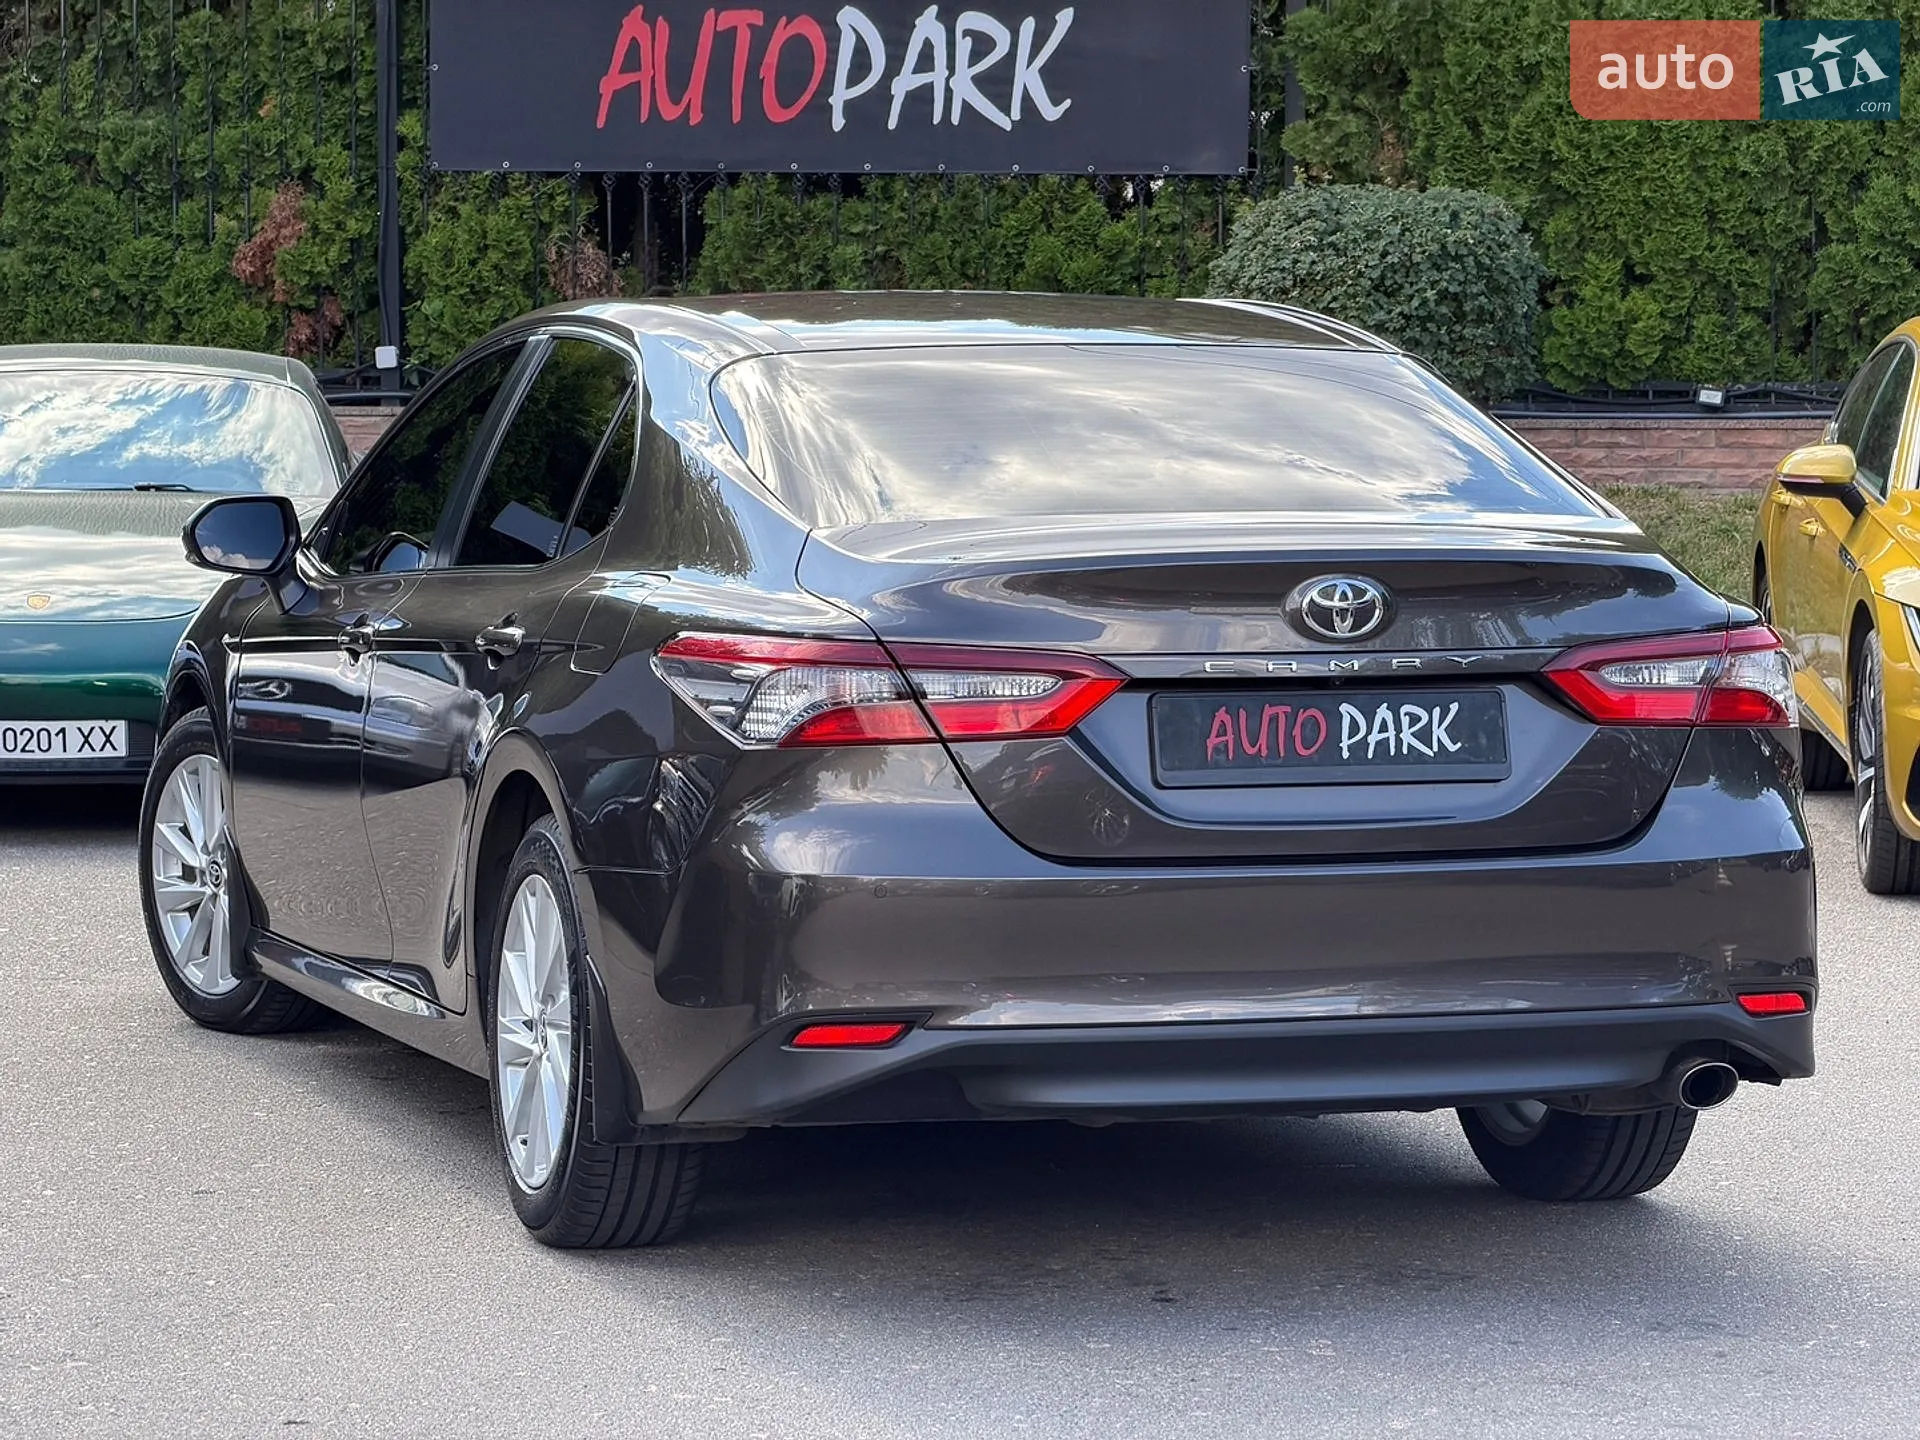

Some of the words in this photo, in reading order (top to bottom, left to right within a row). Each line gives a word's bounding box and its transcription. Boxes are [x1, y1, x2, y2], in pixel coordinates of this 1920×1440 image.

[1203, 655, 1482, 673] CAMRY
[2, 727, 67, 753] 0201
[76, 725, 118, 753] XX
[1206, 703, 1328, 763] AUTO
[1338, 701, 1462, 760] PARK
